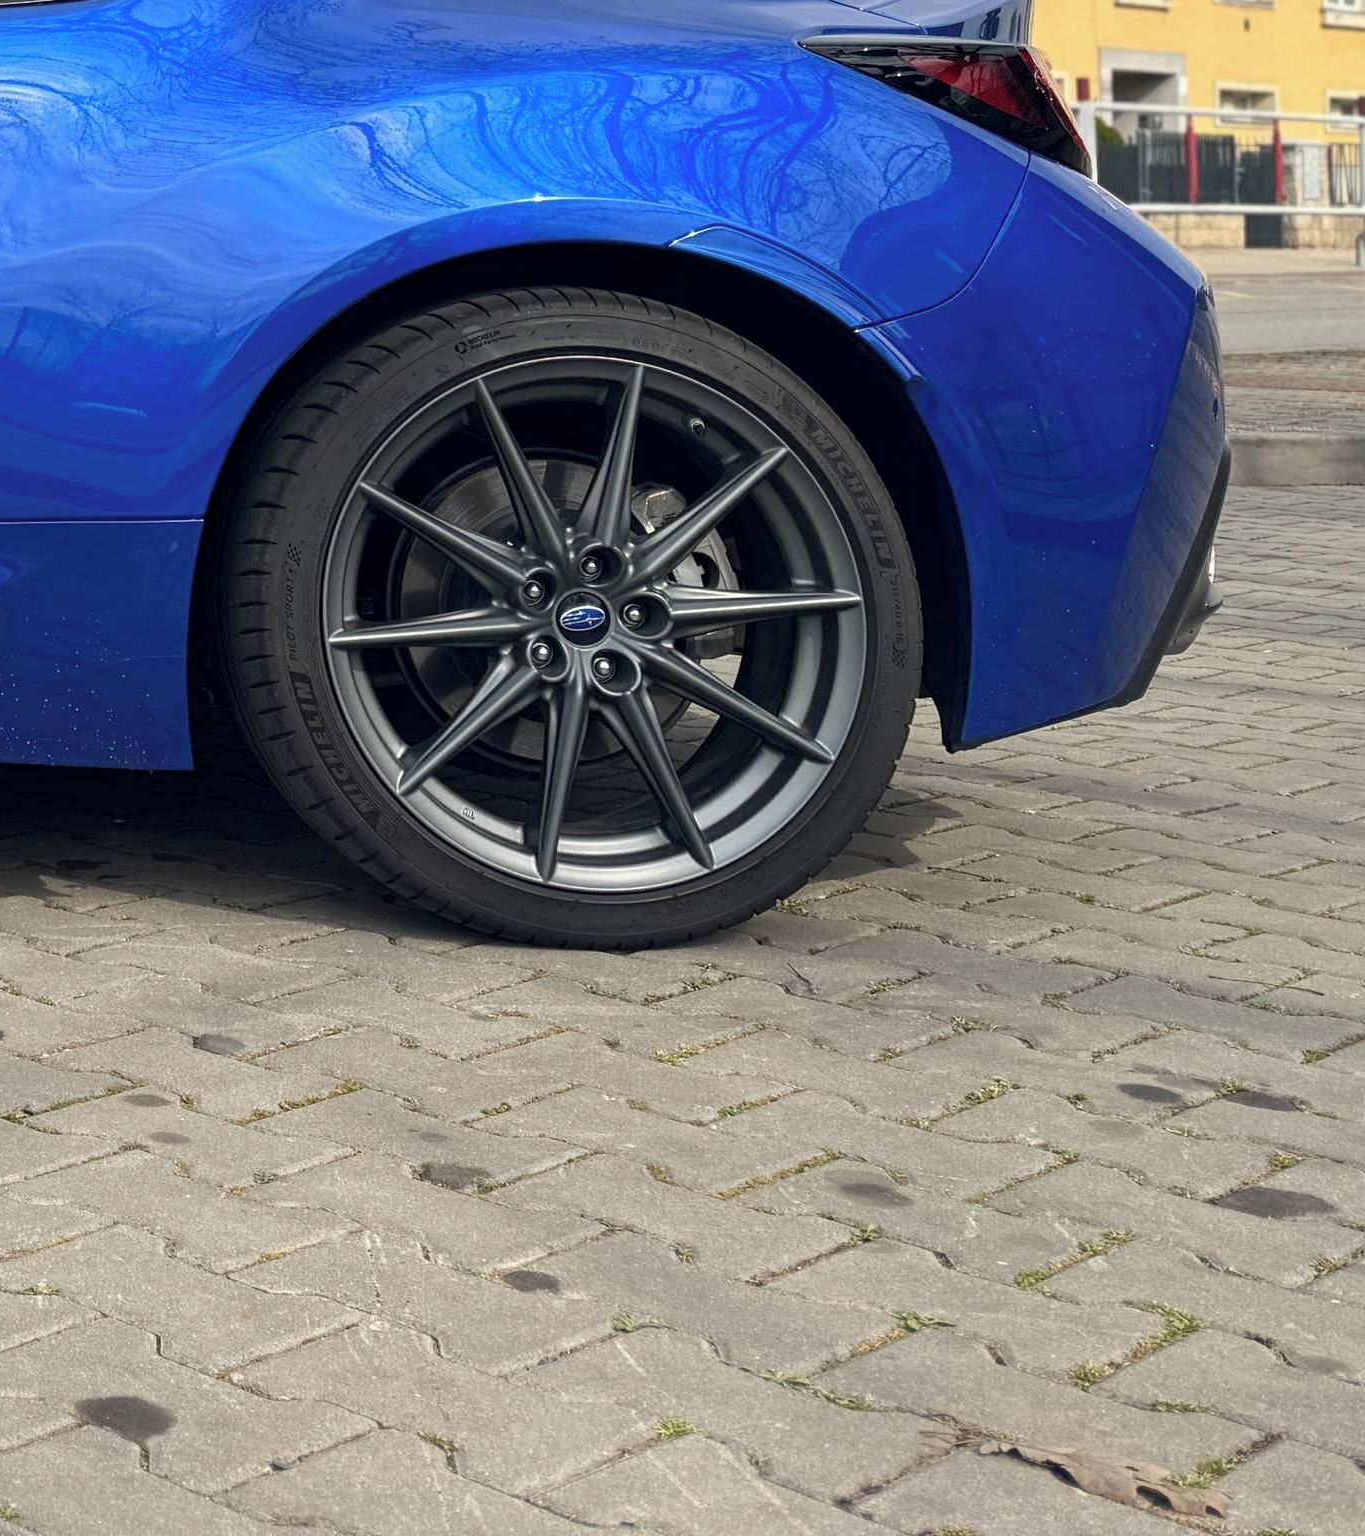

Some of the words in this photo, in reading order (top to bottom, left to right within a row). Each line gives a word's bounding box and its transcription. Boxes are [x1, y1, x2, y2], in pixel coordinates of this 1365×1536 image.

[810, 428, 891, 560] MICHELIN
[284, 578, 296, 621] SPORT
[285, 625, 298, 662] PILOT
[294, 680, 375, 815] MICHELIN
